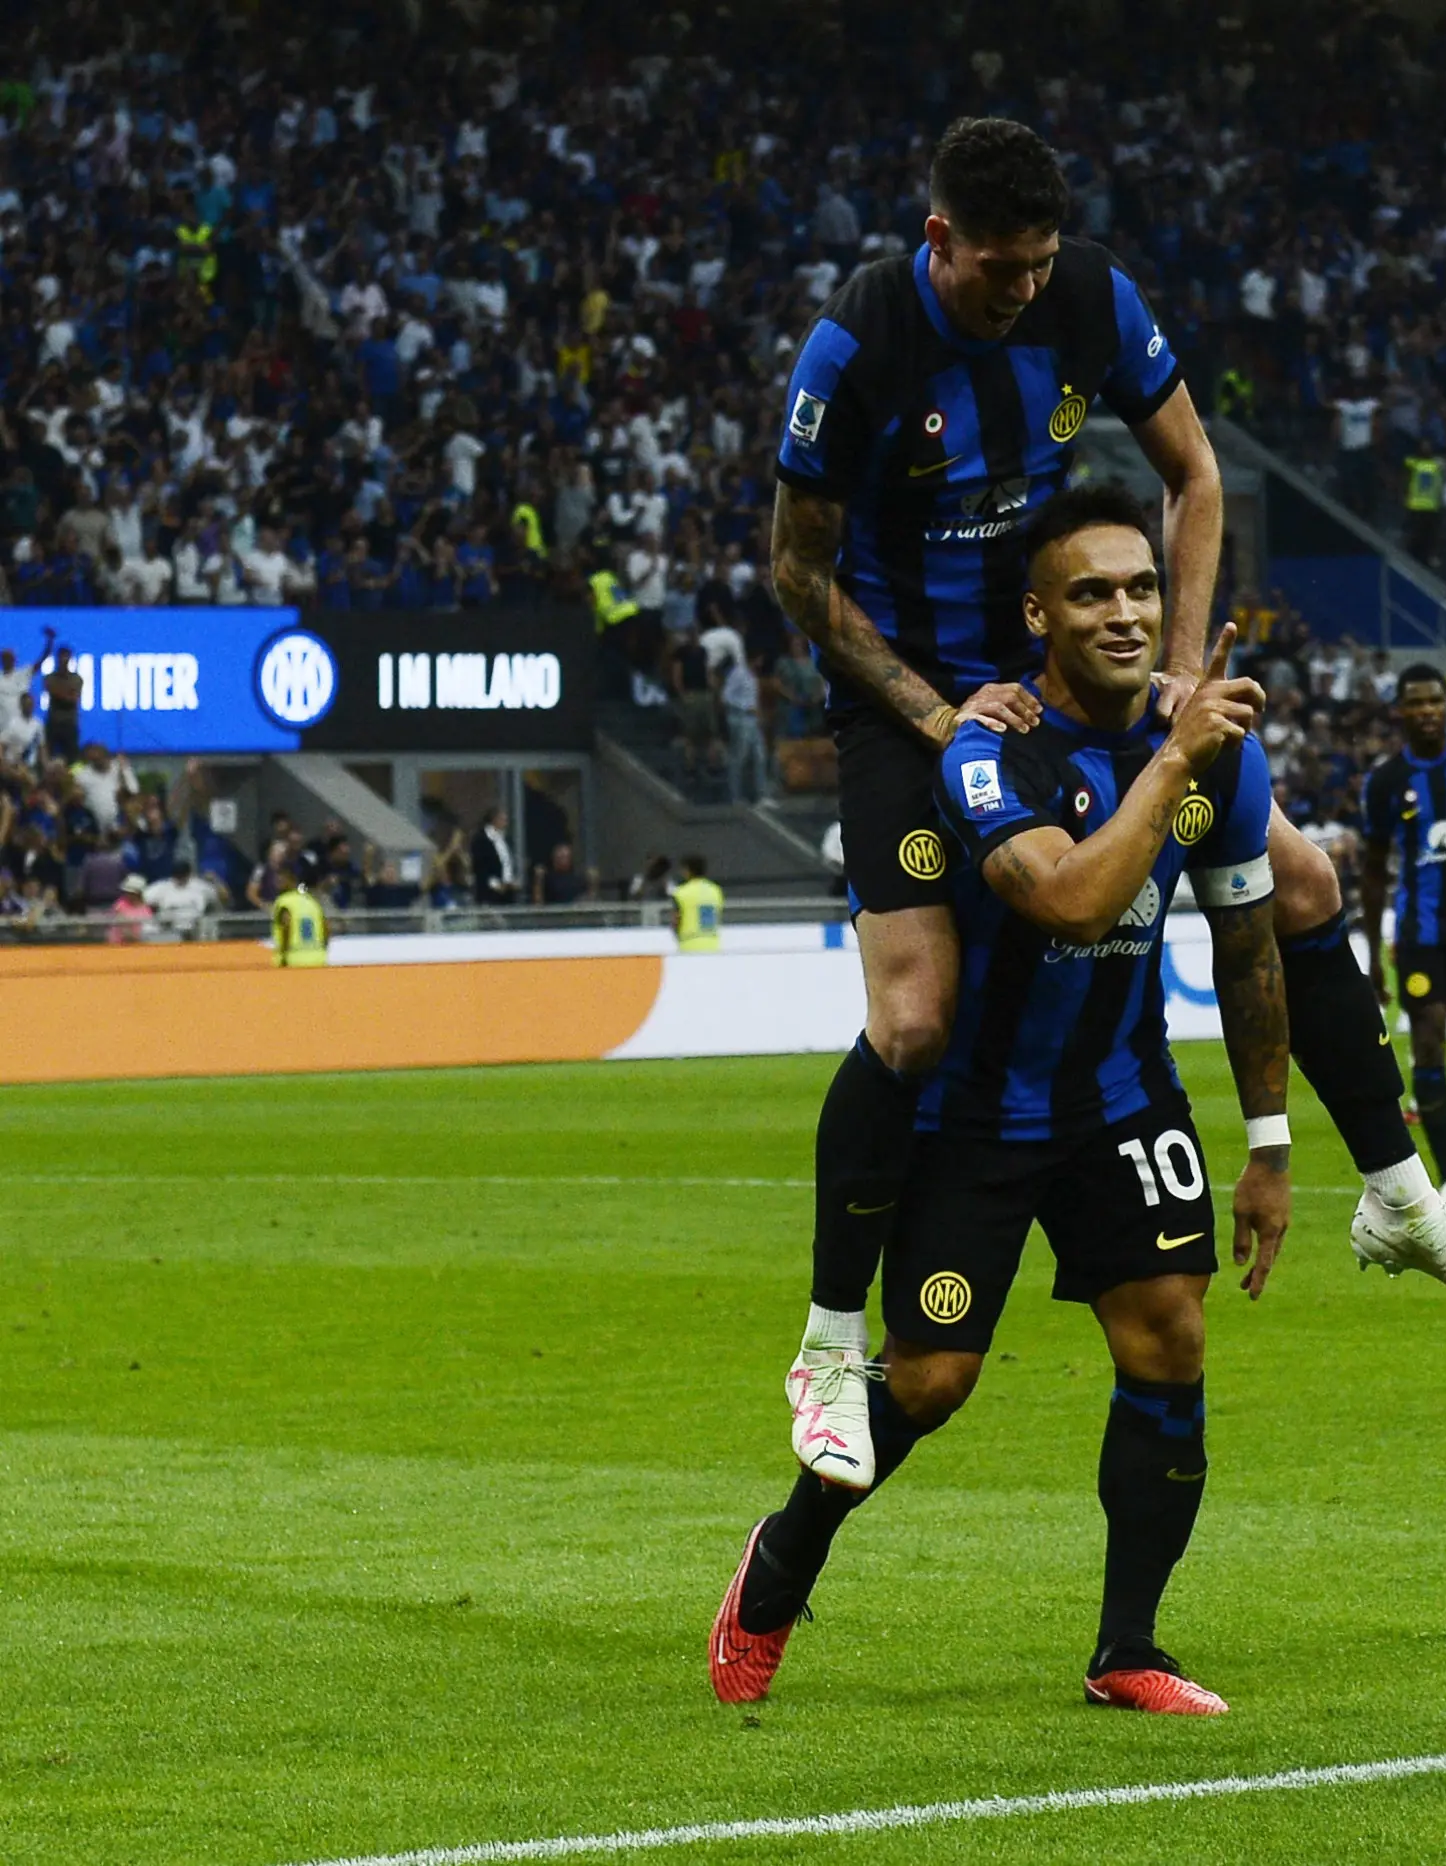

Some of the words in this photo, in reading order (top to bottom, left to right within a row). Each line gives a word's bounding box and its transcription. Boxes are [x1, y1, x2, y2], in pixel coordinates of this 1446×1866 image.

[101, 652, 199, 711] INTER
[379, 653, 393, 709] I
[399, 653, 431, 709] M
[436, 653, 561, 709] MILANO
[1118, 1129, 1204, 1207] 10
